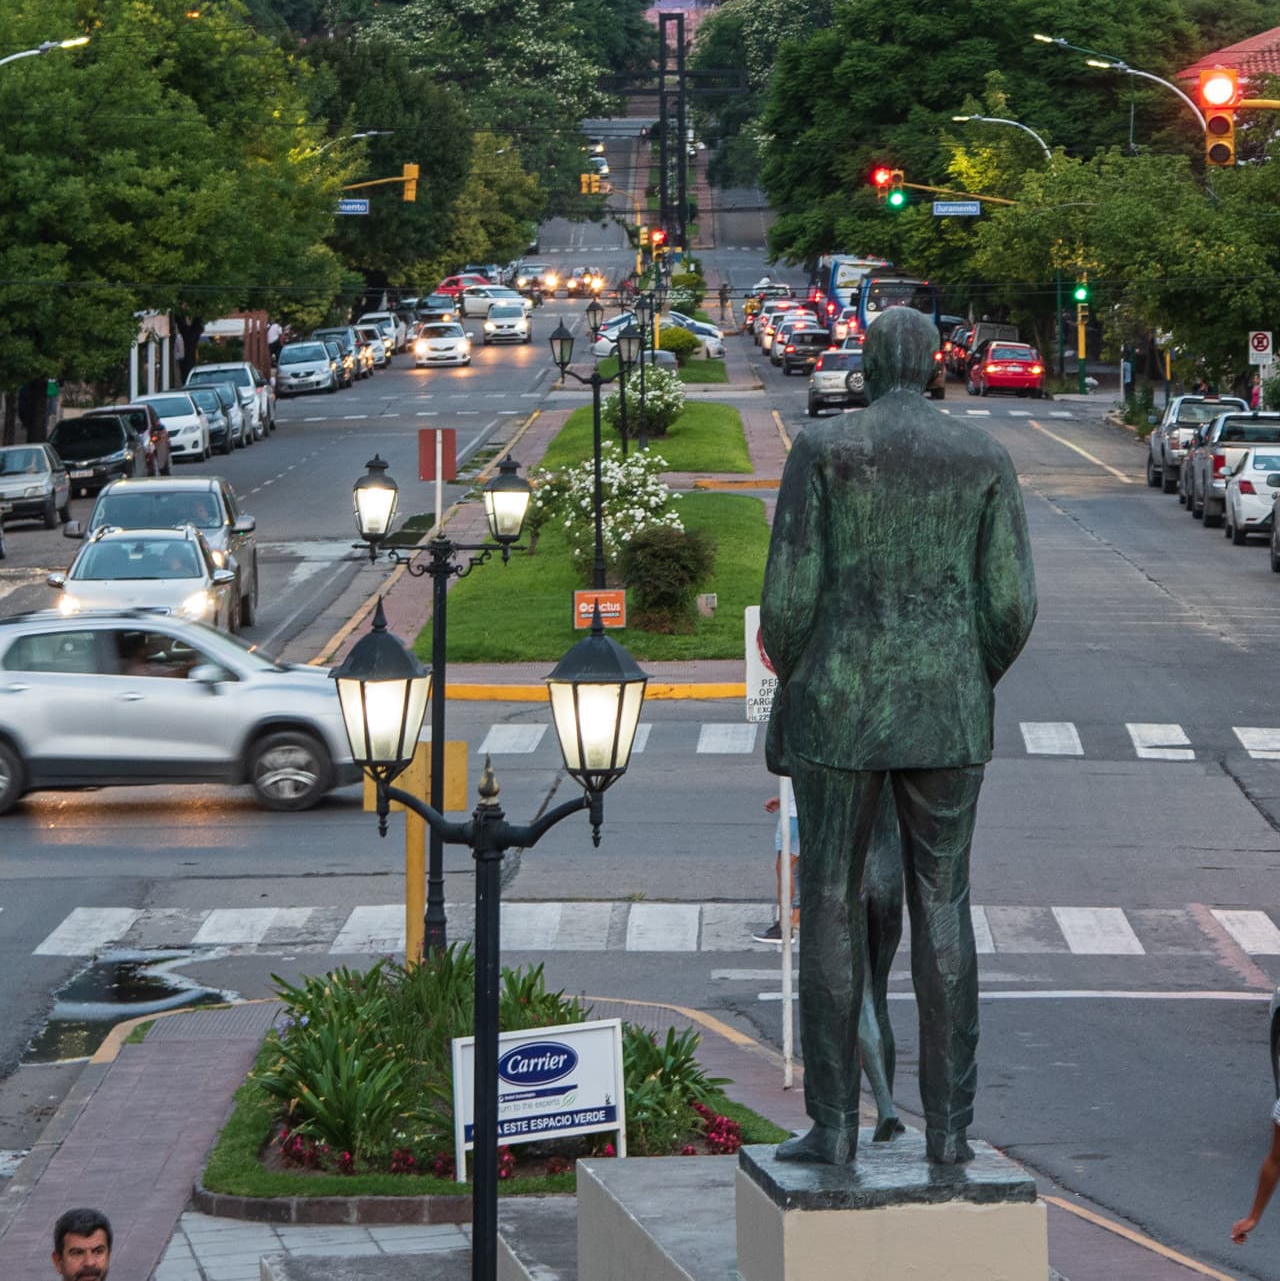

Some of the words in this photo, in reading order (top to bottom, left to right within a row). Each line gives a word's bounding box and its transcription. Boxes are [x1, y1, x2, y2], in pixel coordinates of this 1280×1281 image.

[937, 205, 977, 213] Juramento
[506, 1052, 568, 1075] Carrier
[503, 1120, 529, 1134] ESTE
[531, 1116, 572, 1130] ESPACIO
[573, 1109, 606, 1124] VERDE
